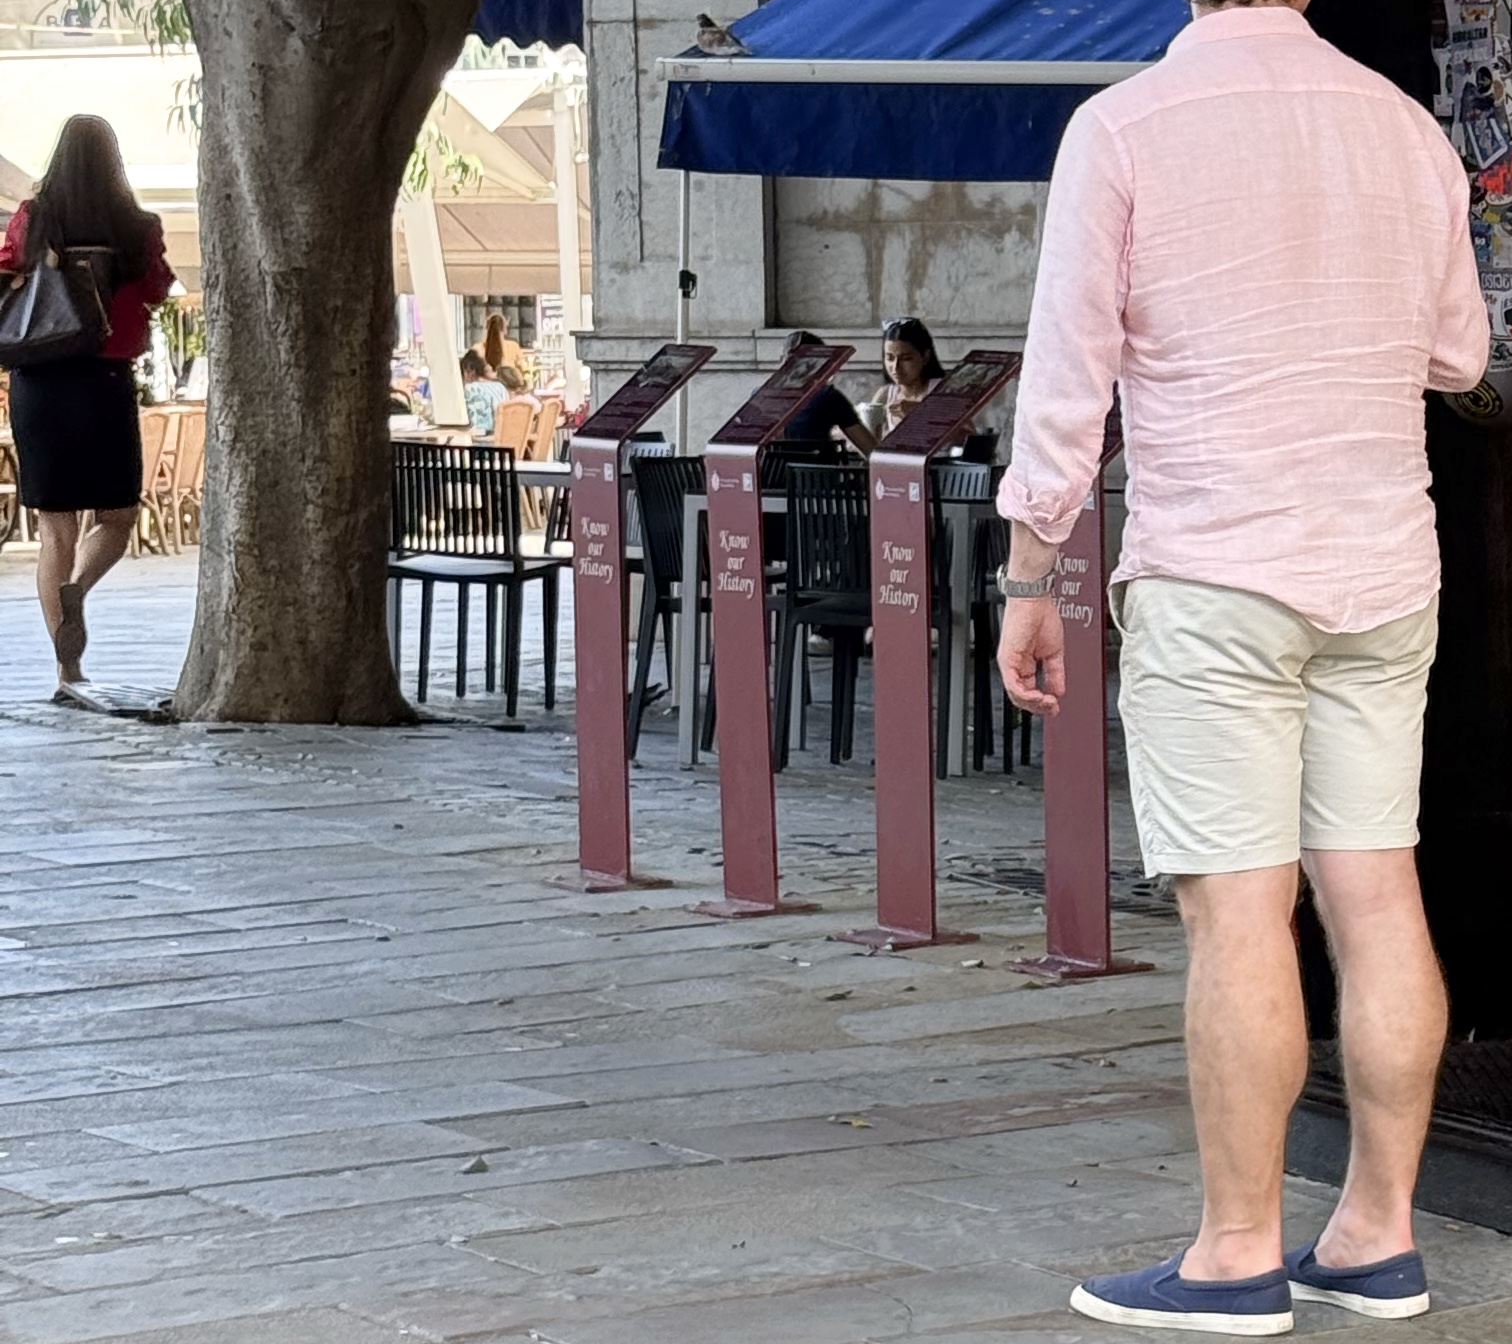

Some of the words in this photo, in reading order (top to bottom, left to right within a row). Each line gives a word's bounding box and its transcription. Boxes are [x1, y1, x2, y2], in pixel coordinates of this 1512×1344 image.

[580, 517, 610, 538] Know
[588, 542, 604, 557] our
[719, 530, 750, 552] Know
[882, 541, 915, 564] Know
[1055, 551, 1090, 576] Know
[579, 557, 614, 585] History
[727, 557, 745, 571] our
[717, 572, 755, 599] History
[890, 567, 910, 584] our
[879, 584, 920, 614] History
[1061, 580, 1083, 596] our
